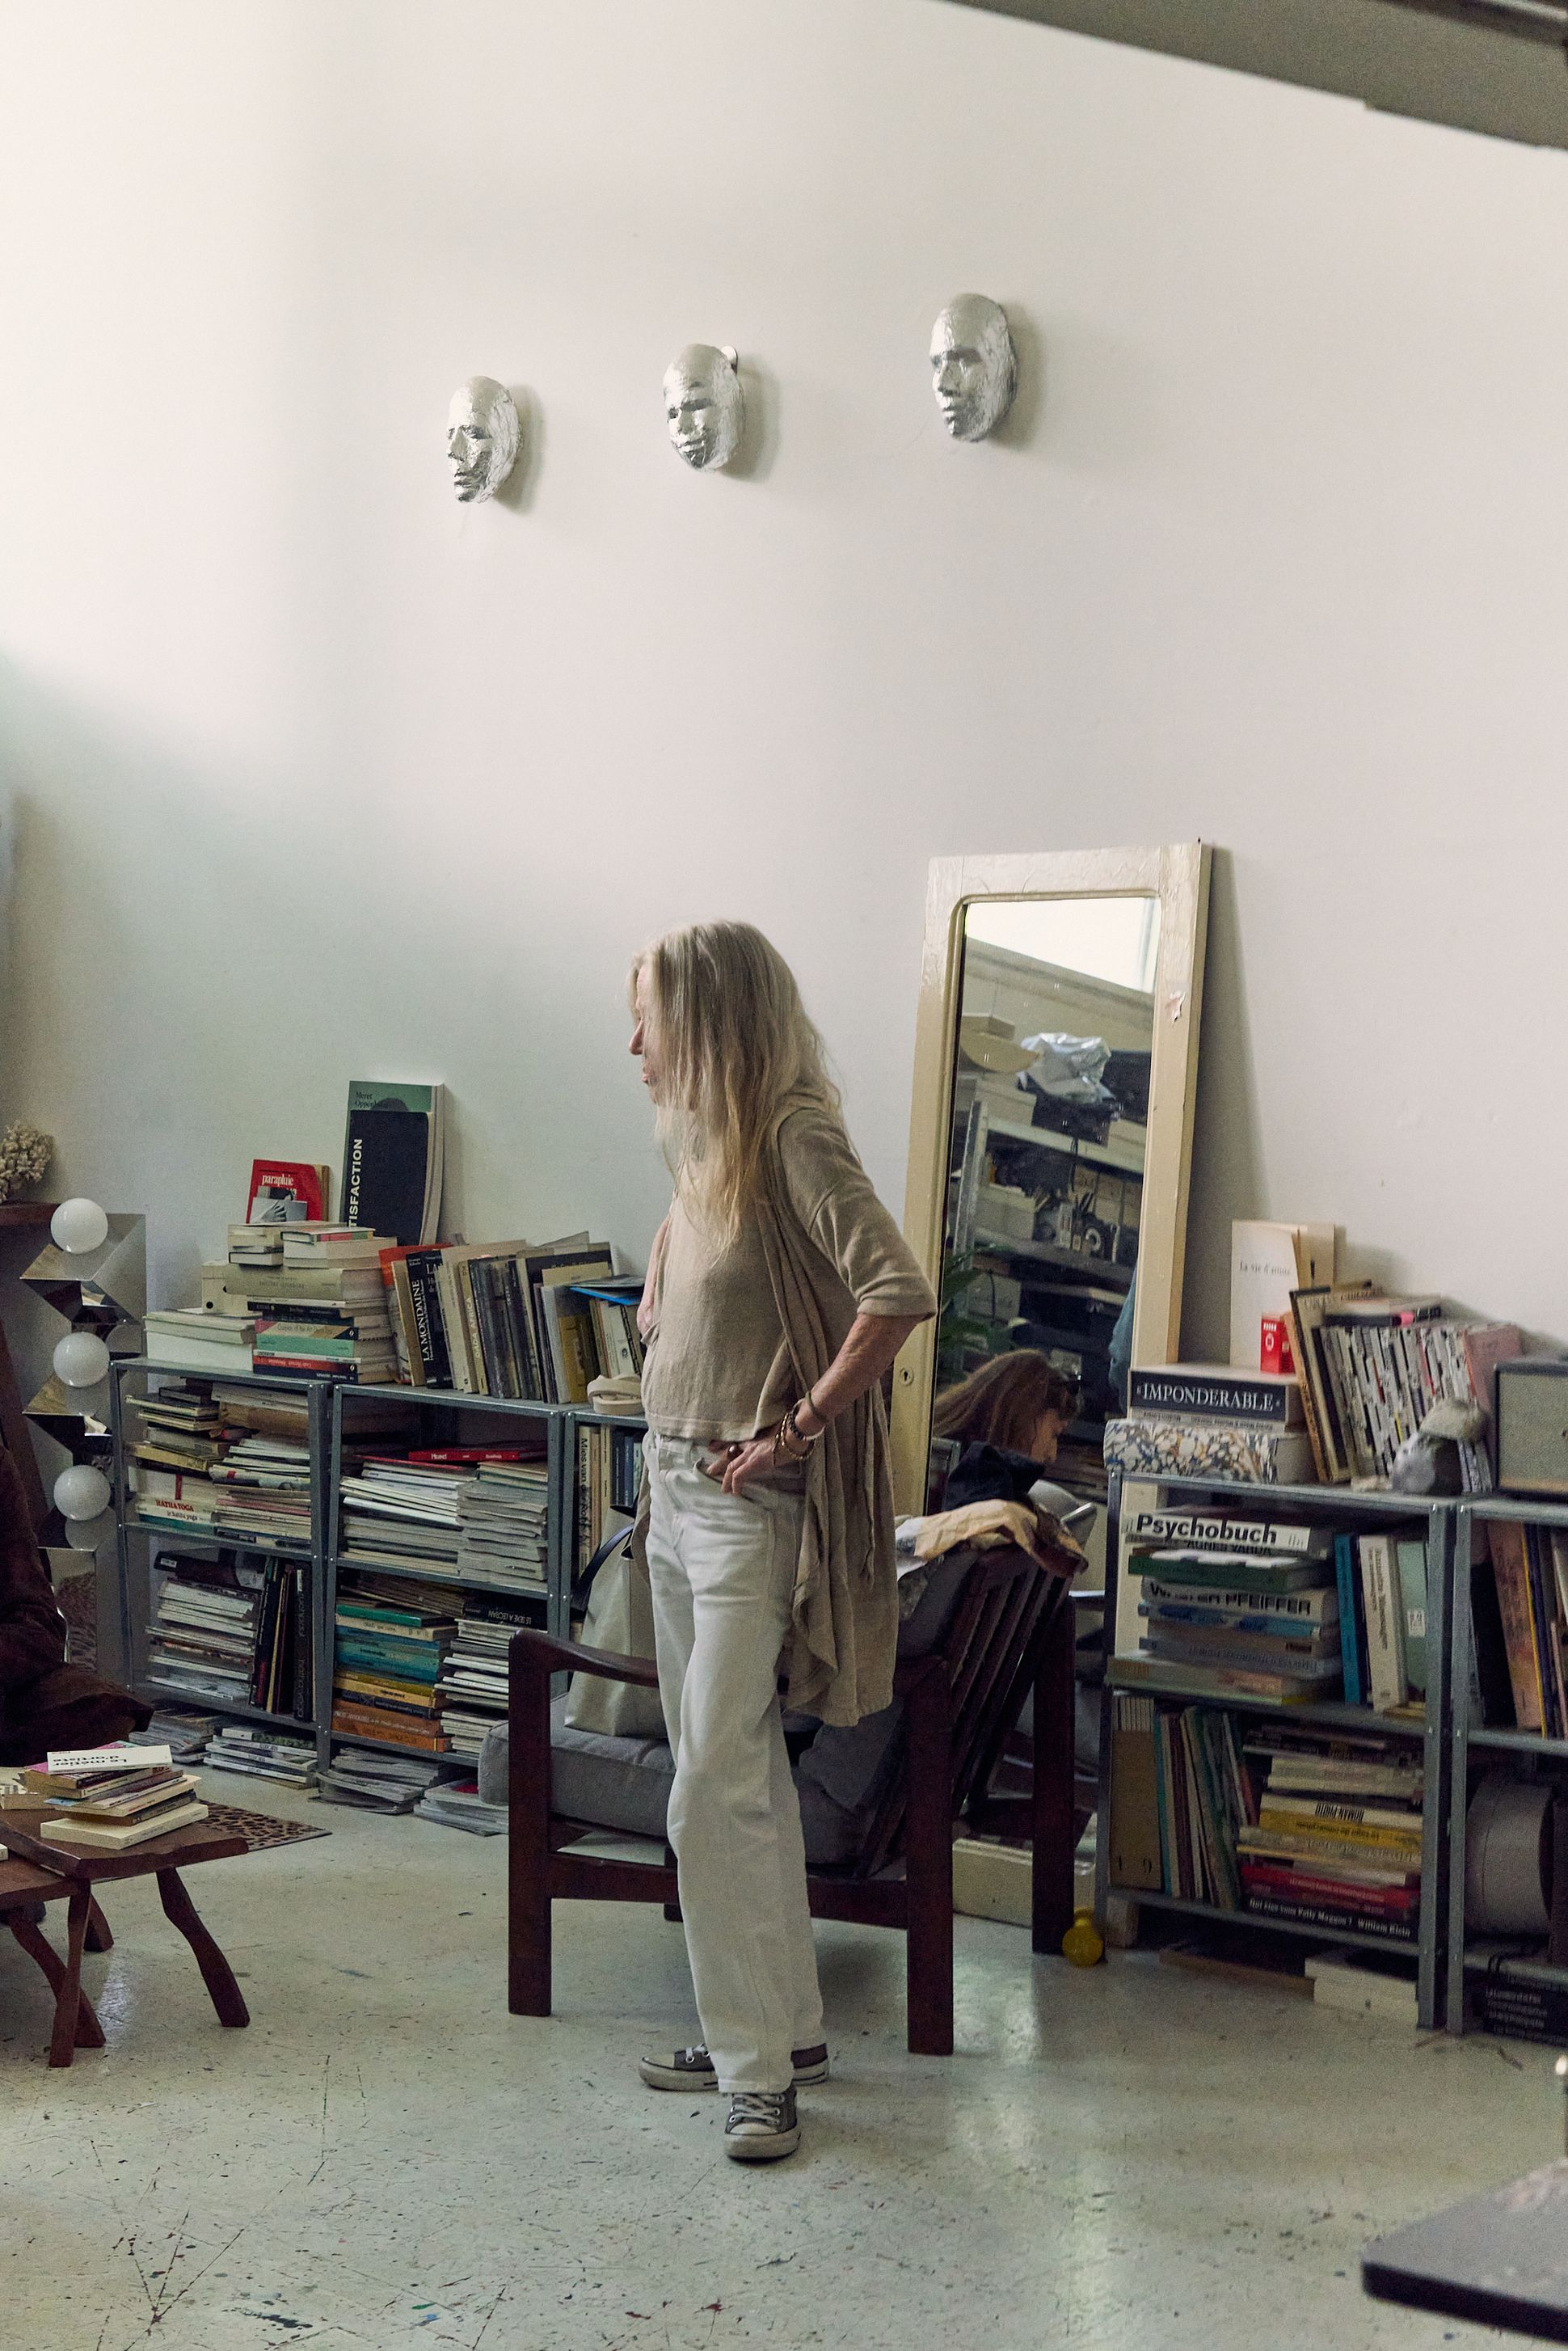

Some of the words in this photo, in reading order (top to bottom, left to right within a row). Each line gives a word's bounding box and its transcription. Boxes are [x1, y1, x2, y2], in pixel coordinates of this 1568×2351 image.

[262, 1173, 293, 1187] parapluie
[412, 1280, 429, 1344] MONDAINE
[466, 1297, 477, 1327] AFRICA
[423, 1345, 430, 1361] LA
[472, 1332, 481, 1358] DADA
[580, 1437, 588, 1462] Mies
[1136, 1513, 1276, 1545] Psychobuch
[1298, 1905, 1317, 1919] Polly
[1358, 1918, 1389, 1934] William
[1389, 1923, 1410, 1938] Klein
